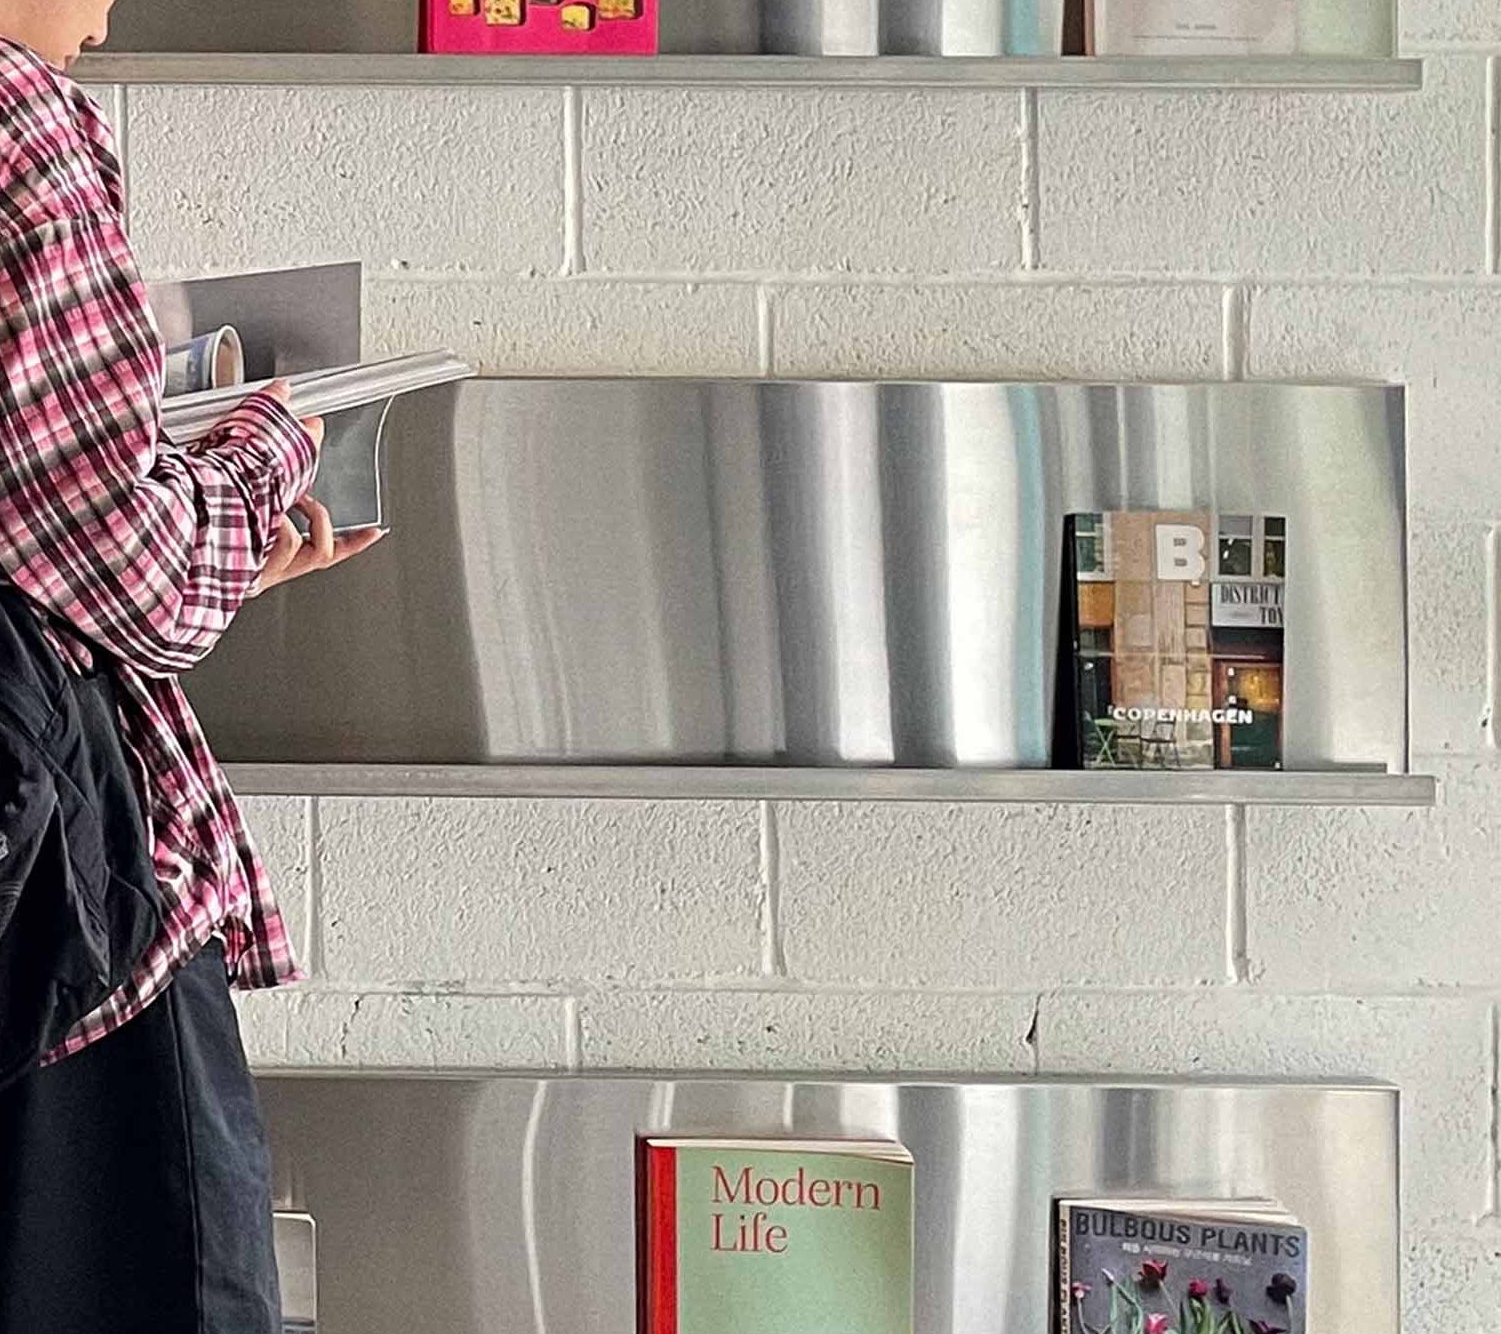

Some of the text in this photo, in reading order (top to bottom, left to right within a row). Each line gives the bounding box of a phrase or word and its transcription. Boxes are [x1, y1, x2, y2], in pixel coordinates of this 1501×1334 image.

[1155, 524, 1206, 580] B
[1220, 584, 1281, 605] DISTRICT
[1113, 707, 1253, 724] COPENHAGEN
[712, 1164, 882, 1211] Modern
[711, 1212, 789, 1254] Life
[1075, 1213, 1191, 1245] BULBOUS
[1201, 1227, 1300, 1257] PLANTS
